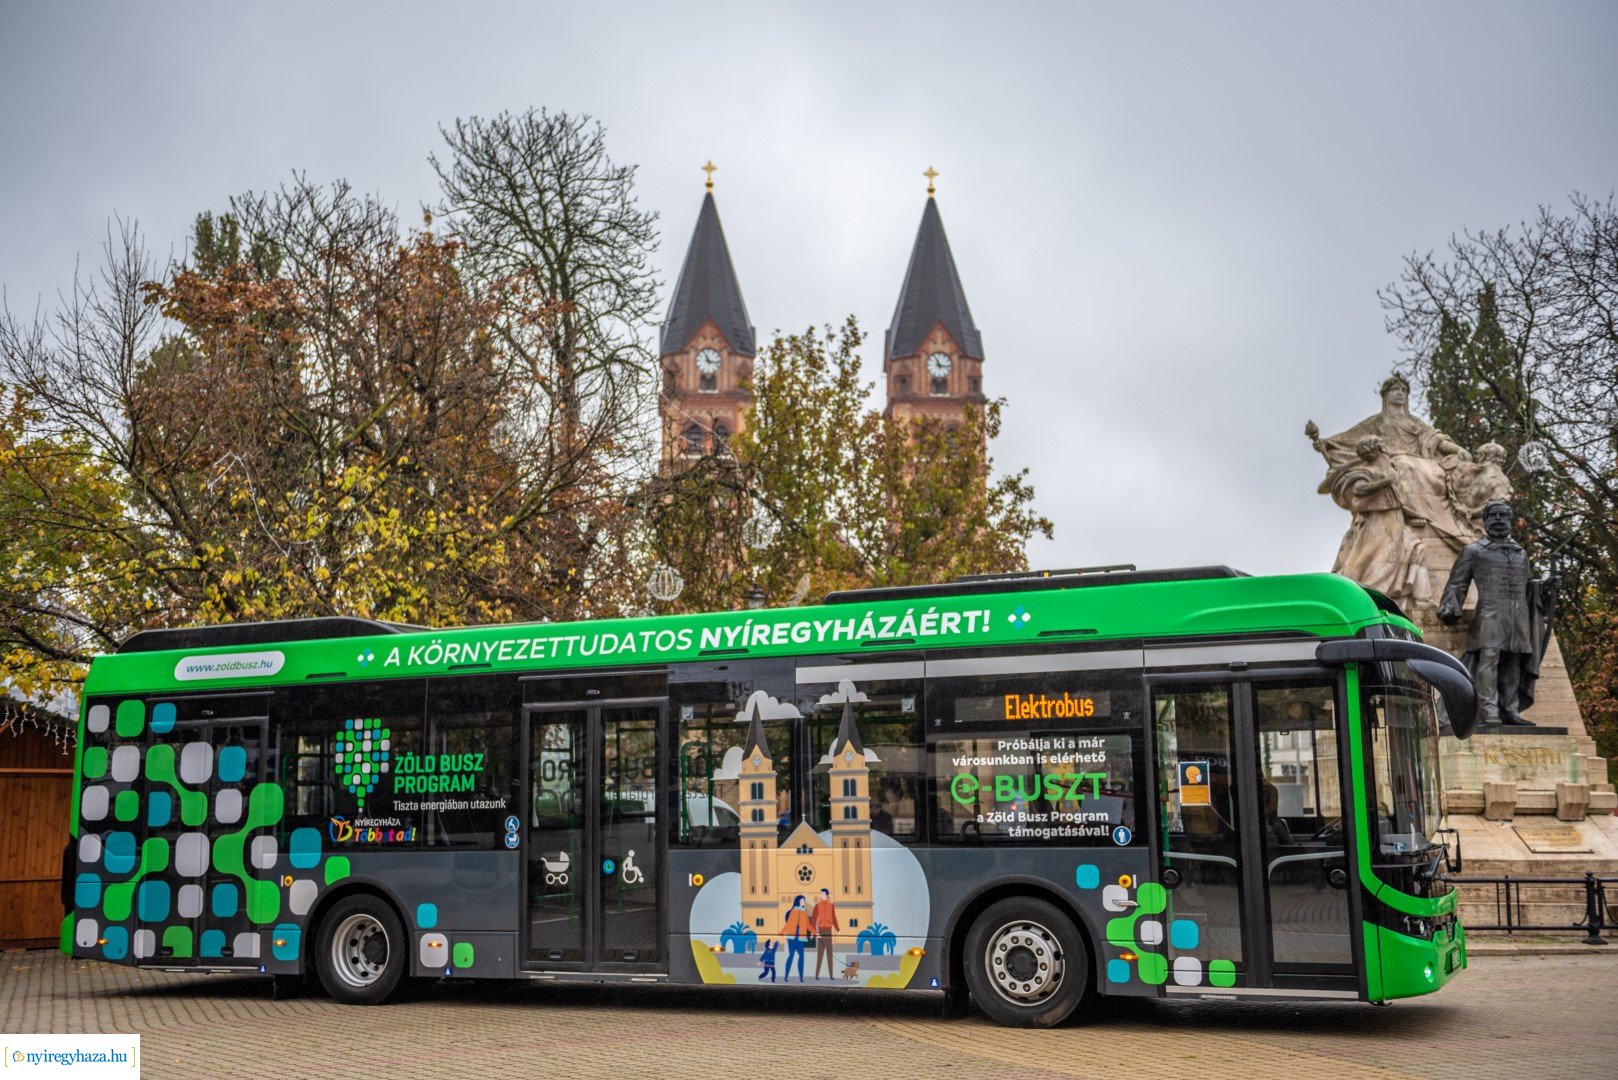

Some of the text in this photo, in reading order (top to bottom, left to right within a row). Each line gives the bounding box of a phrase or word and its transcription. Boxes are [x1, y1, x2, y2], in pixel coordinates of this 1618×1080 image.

[383, 606, 991, 667] A KÖRNYEZETTUDATOS NYÍREGYHÁZÁÉRT!
[186, 659, 273, 673] www.zoldbusz.hu
[1004, 692, 1094, 720] Elektrobus
[998, 737, 1106, 752] Próbálja ki a már
[394, 752, 484, 774] ZÖLD BUSZ
[952, 751, 1106, 766] városunkban is elérhető
[394, 774, 475, 794] PROGRAM
[393, 798, 507, 813] Tiszta energiában utazunk
[354, 817, 401, 827] NYÍREGYHÁZA
[977, 811, 1109, 825] a Zöld Busz Program
[396, 827, 417, 842] ad!
[1008, 825, 1110, 838] támogatásával!
